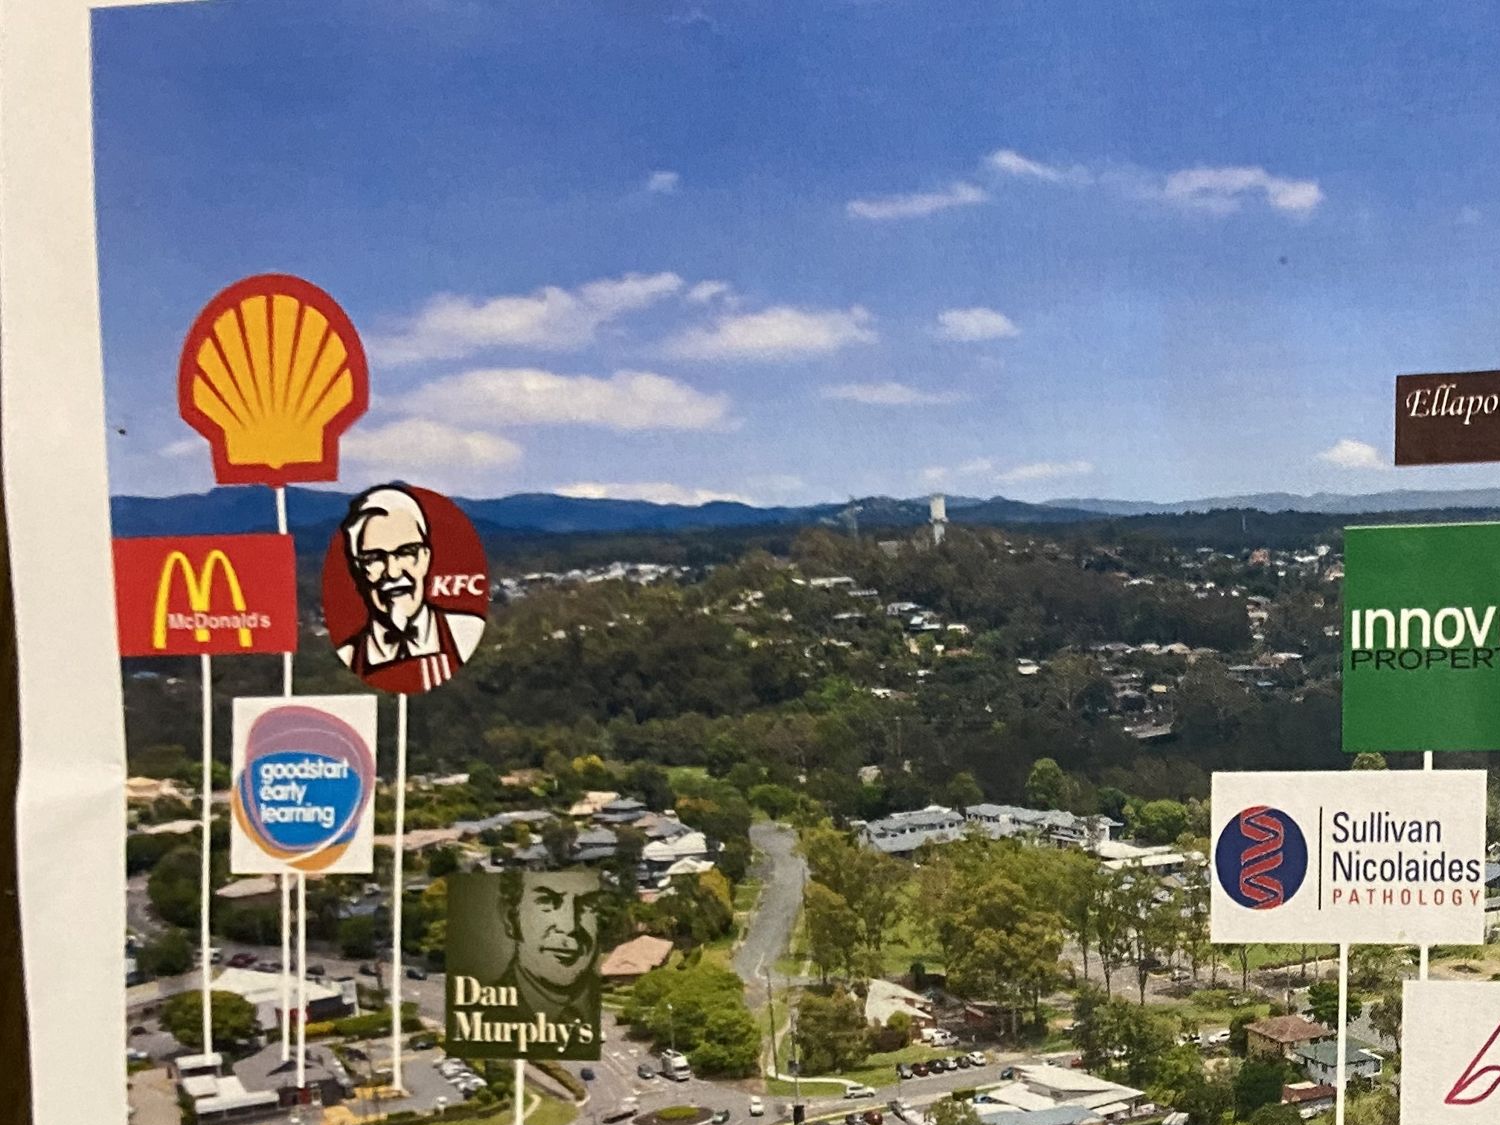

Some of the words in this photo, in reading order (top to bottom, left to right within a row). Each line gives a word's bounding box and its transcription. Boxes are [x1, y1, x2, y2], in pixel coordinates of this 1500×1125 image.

[430, 573, 486, 597] KFC
[168, 612, 271, 631] McDonald's
[260, 757, 348, 783] goodstart
[260, 784, 307, 806] early
[260, 802, 336, 827] learning
[1332, 811, 1442, 845] Sullivan
[1332, 850, 1481, 883] Nicolaides
[1332, 888, 1481, 907] PATHOLOGY
[454, 975, 519, 1007] Dan
[452, 1011, 594, 1053] Murphy's
